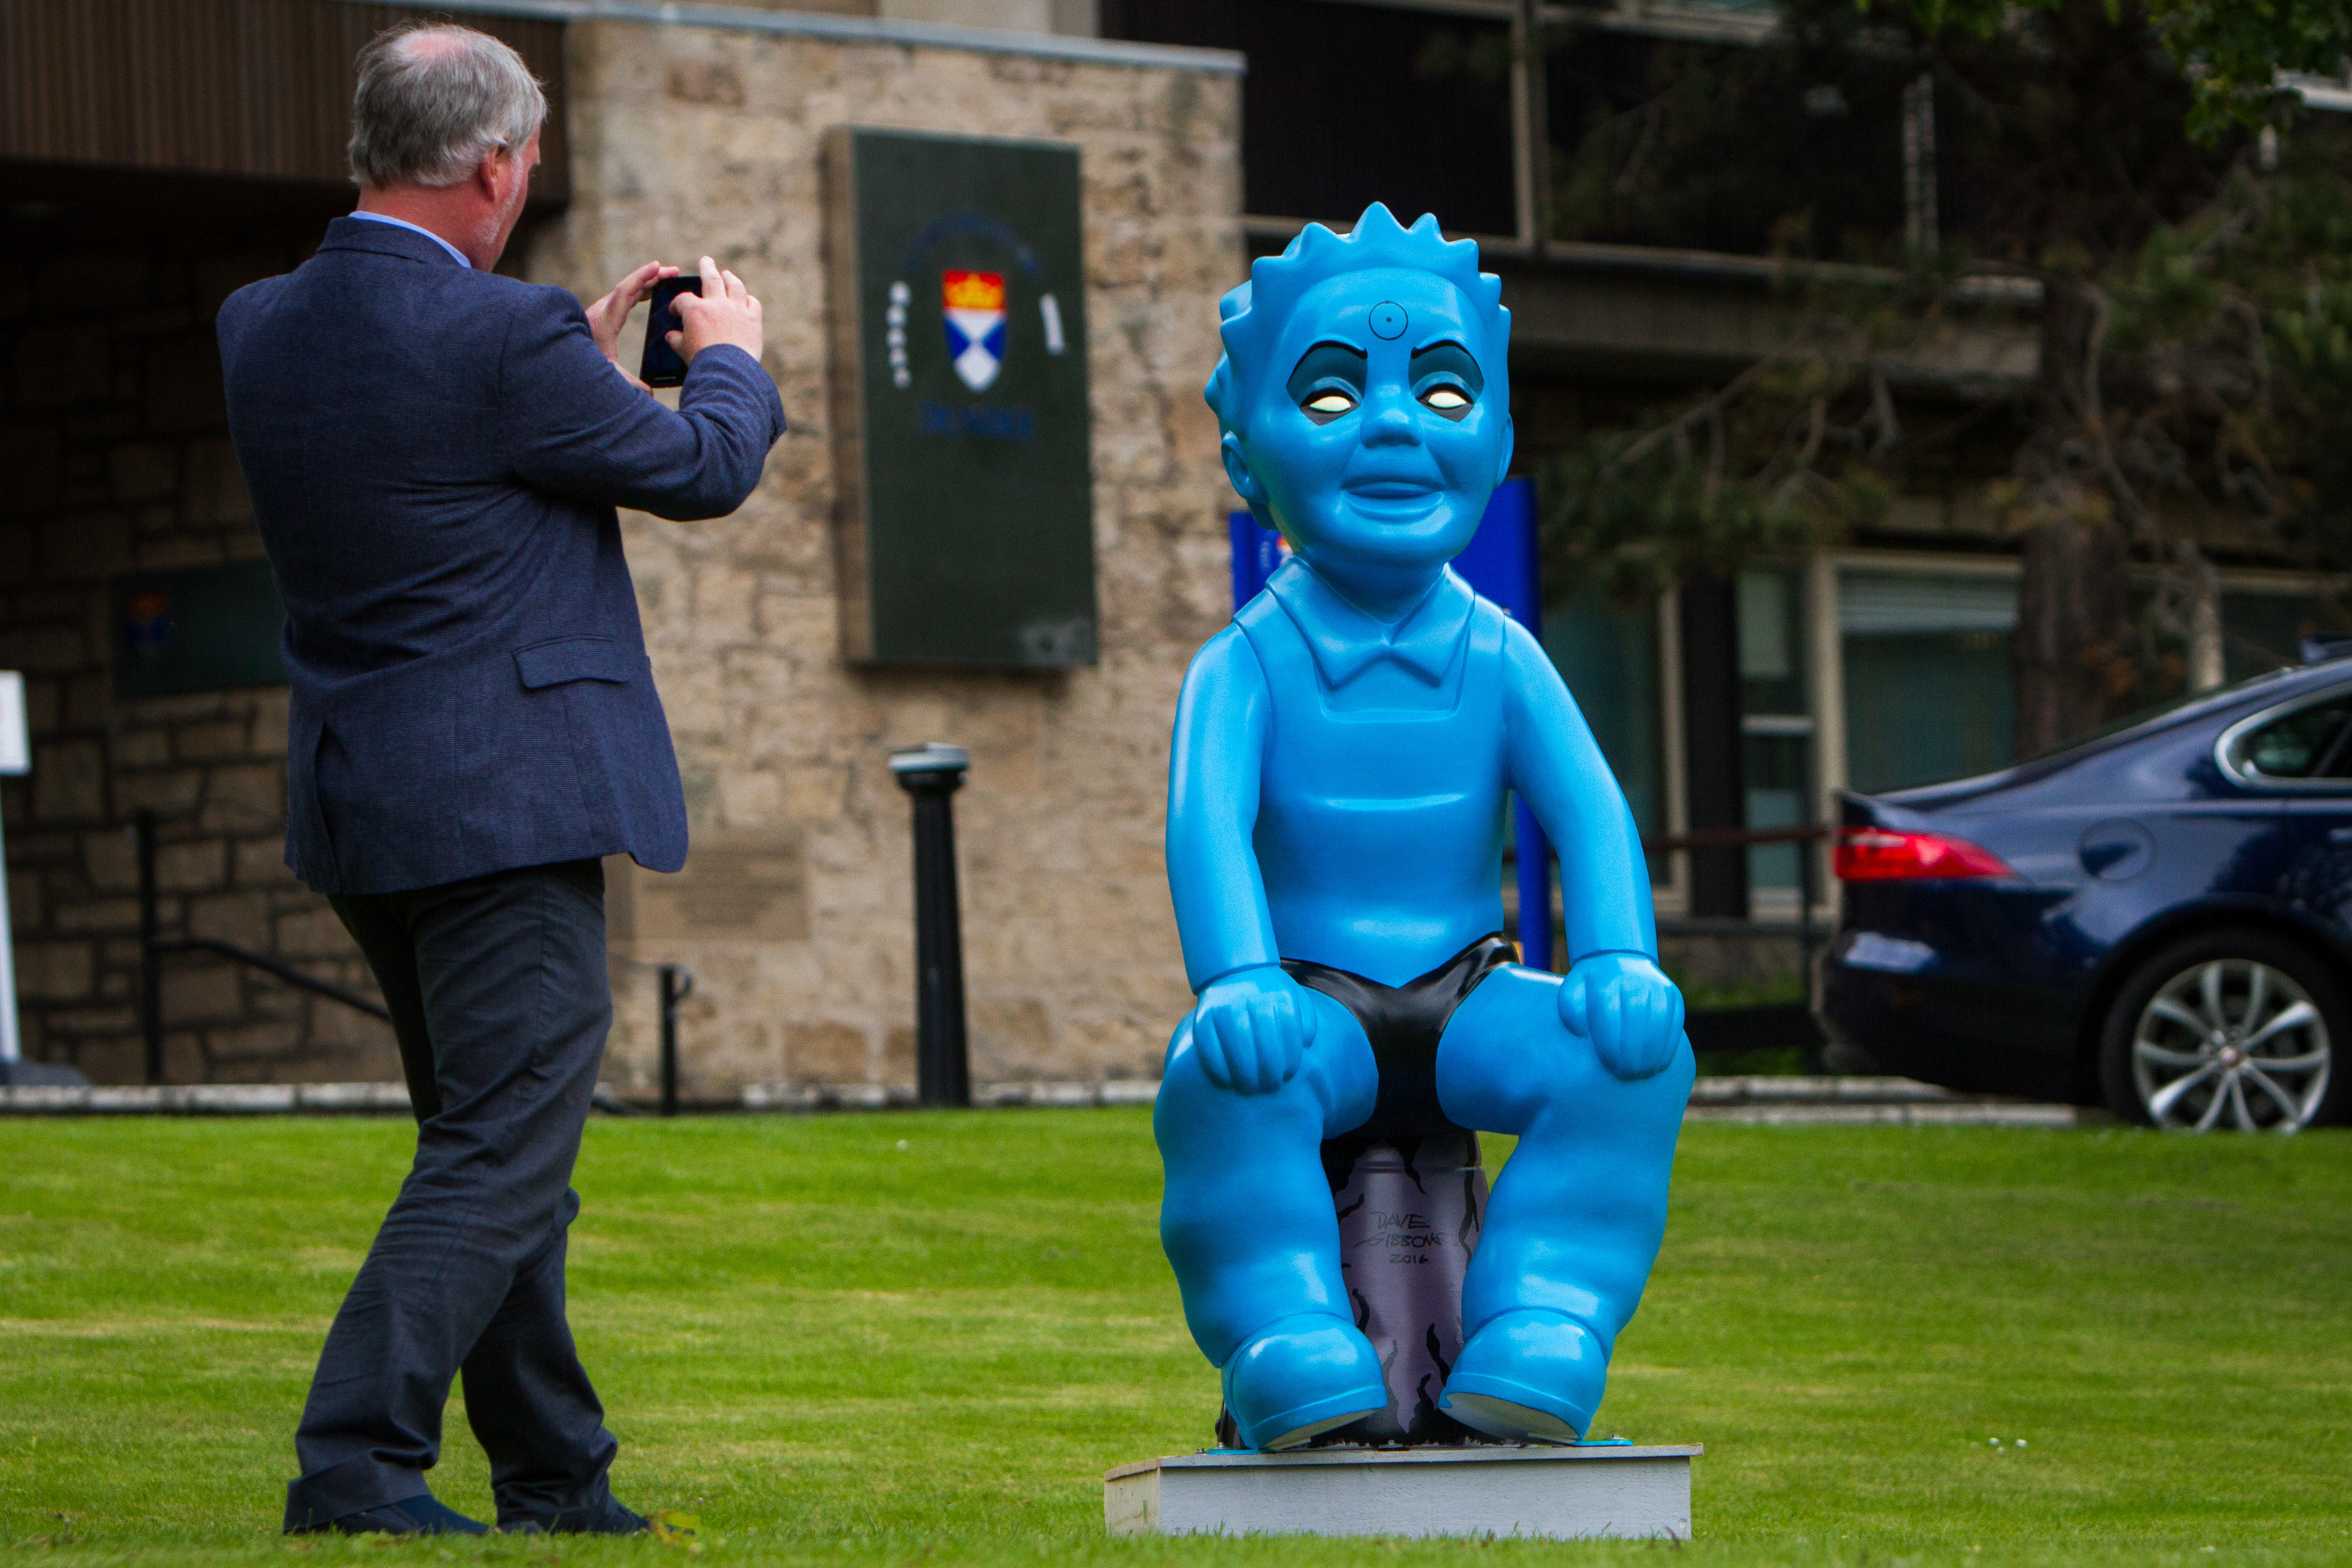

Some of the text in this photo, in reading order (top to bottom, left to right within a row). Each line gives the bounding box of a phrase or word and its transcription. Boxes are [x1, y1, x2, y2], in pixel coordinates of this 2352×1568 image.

[1369, 1211, 1432, 1230] DAVE
[1355, 1231, 1445, 1248] GIBBONS
[1389, 1254, 1429, 1265] 2016
